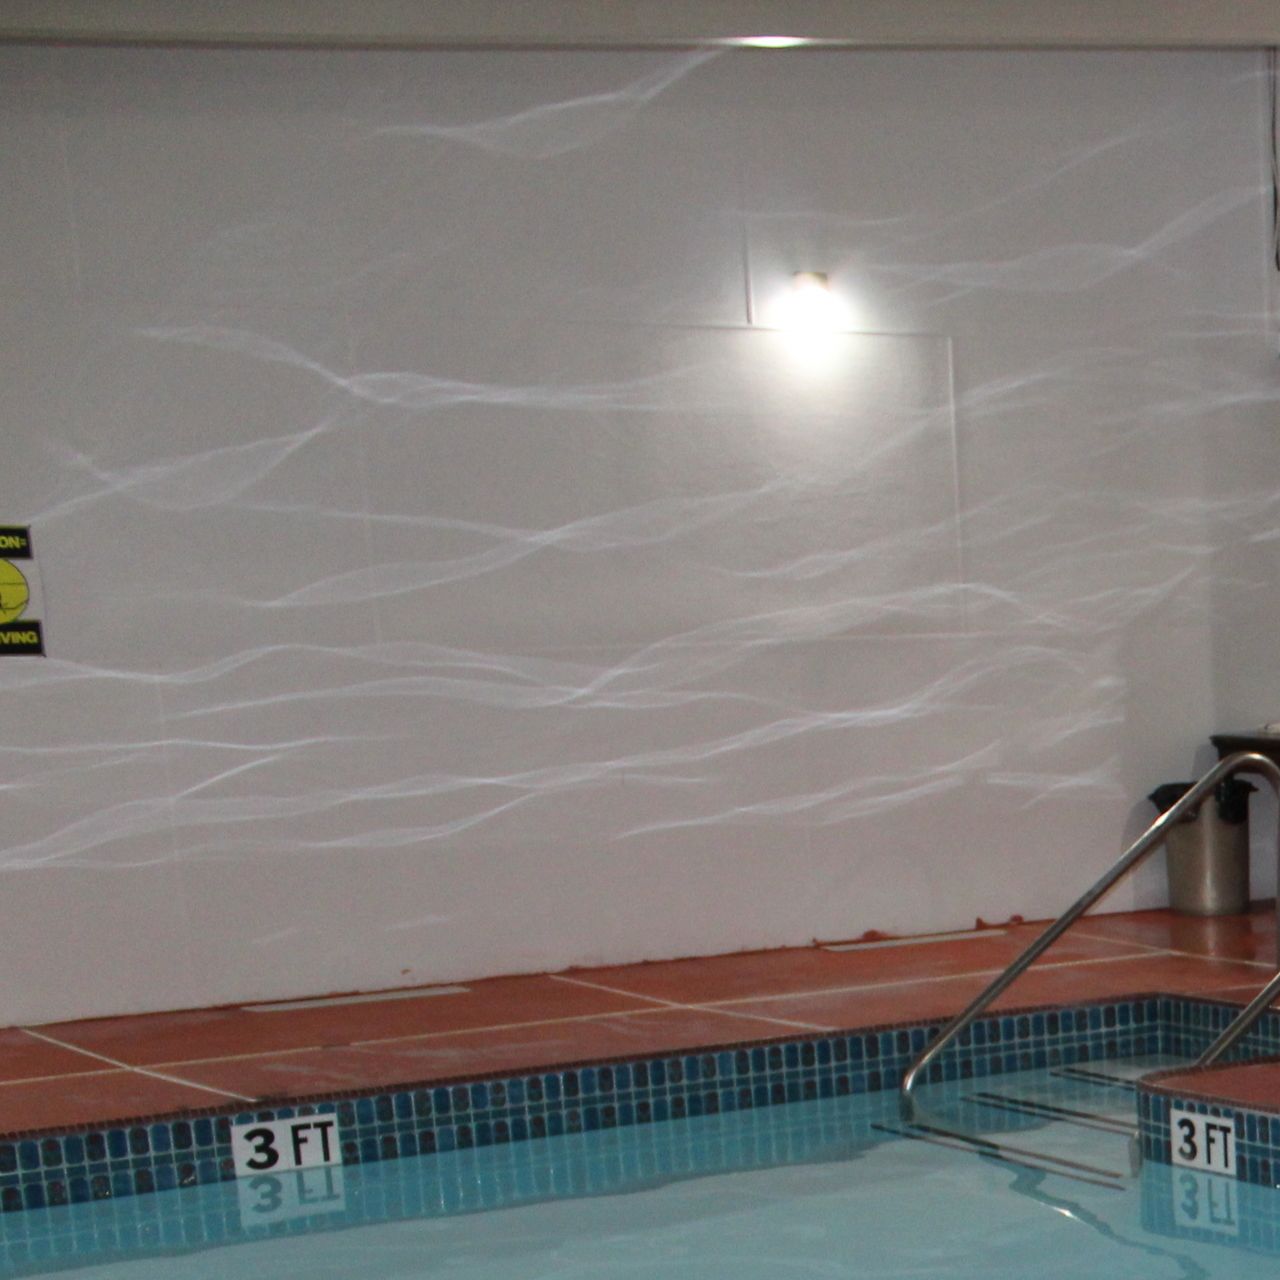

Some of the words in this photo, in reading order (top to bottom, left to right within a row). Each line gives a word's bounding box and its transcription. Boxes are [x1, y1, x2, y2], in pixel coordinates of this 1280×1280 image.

[244, 1128, 279, 1170] 3
[291, 1120, 334, 1166] FT
[1177, 1118, 1198, 1162] 3
[1205, 1122, 1232, 1169] FT
